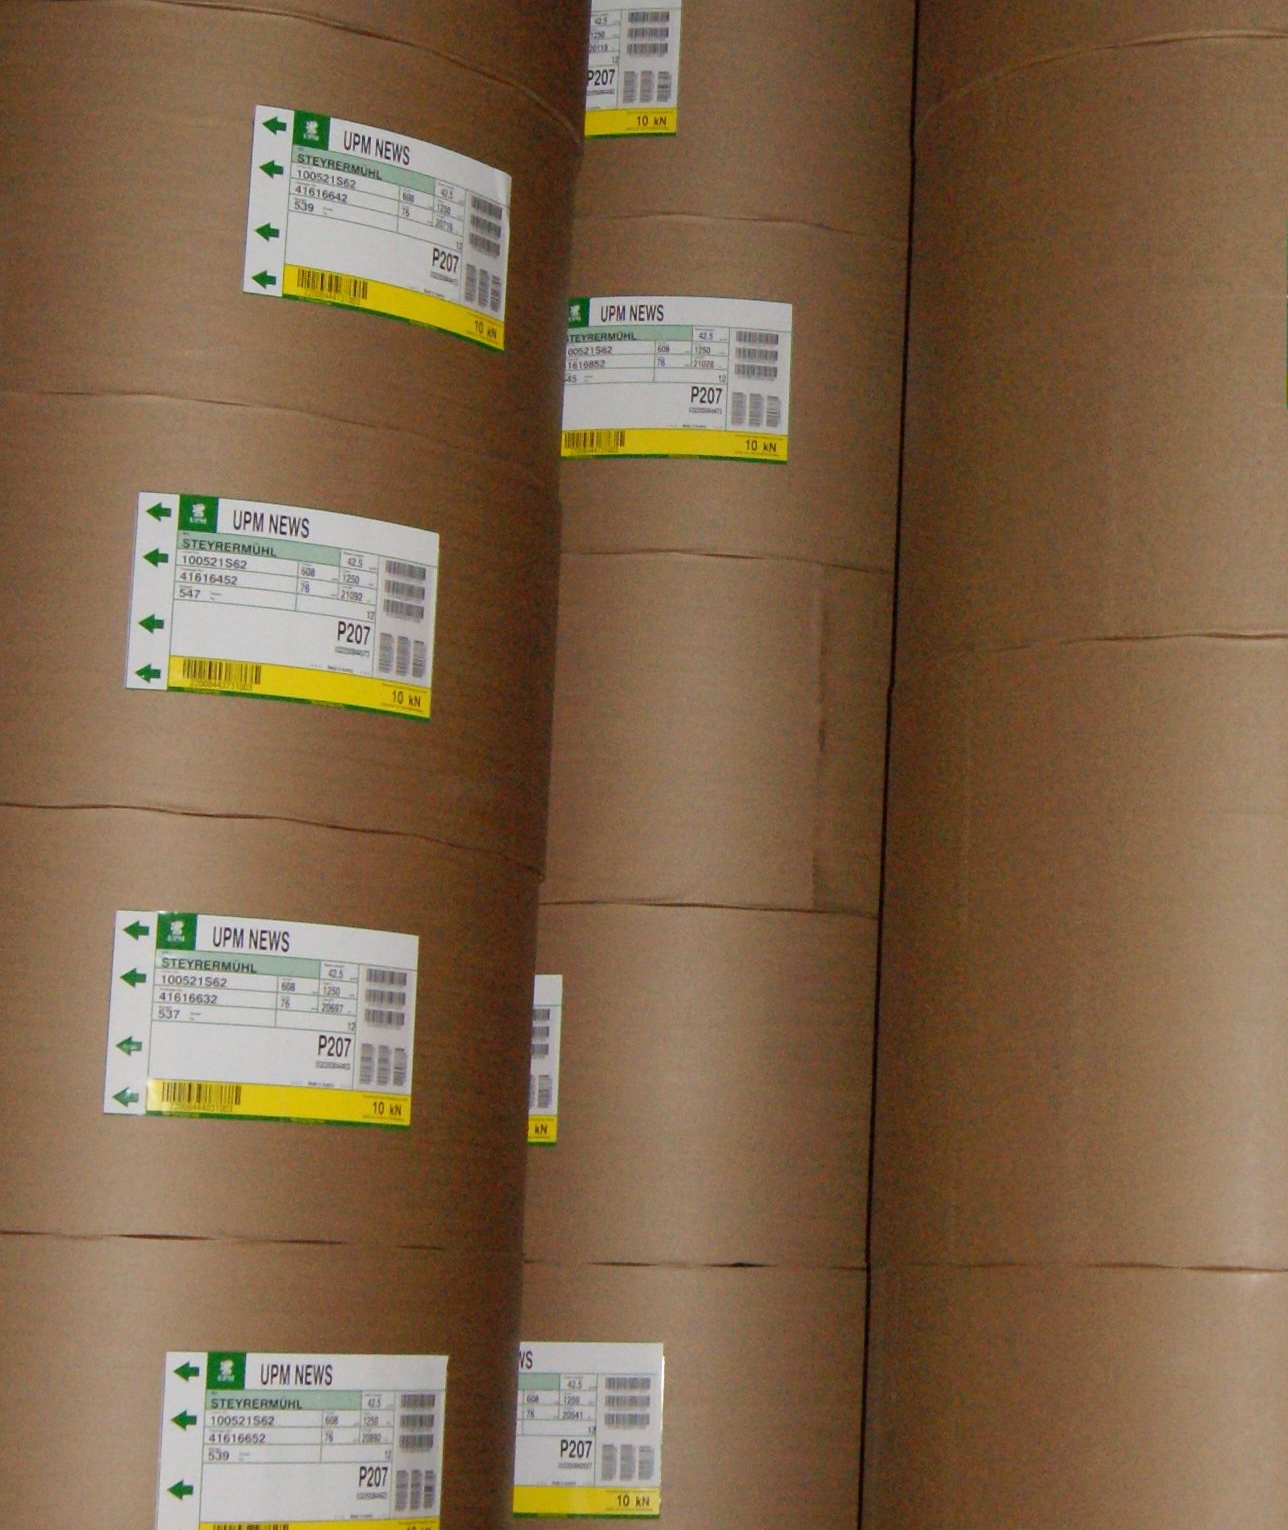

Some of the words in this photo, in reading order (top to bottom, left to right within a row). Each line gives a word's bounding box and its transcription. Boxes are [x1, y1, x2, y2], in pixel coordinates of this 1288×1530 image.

[344, 131, 371, 153] UPM
[375, 140, 410, 165] NEWS
[295, 186, 348, 202] 41616642
[295, 201, 314, 212] 539
[601, 305, 625, 322] UPM
[630, 305, 664, 322] NEWS
[691, 386, 722, 404] P207
[745, 440, 758, 451] 10
[763, 441, 776, 452] kN
[233, 510, 264, 531] UPM
[269, 514, 310, 538] NEWS
[183, 538, 276, 557] STEYRERMÜHL
[183, 556, 247, 569] 100521S62
[347, 557, 363, 568] 42.5
[180, 572, 237, 585] 41616452
[343, 574, 360, 585] 1250
[179, 589, 200, 599] 547
[337, 621, 370, 645] P207
[392, 690, 403, 705] 10
[409, 694, 421, 706] kN
[213, 926, 244, 948] UPM
[249, 929, 290, 952] NEWS
[162, 958, 257, 973] STEYRERMÜHL
[161, 975, 227, 988] 100521S62
[159, 992, 217, 1004] 41616632
[158, 1010, 180, 1019] 537
[318, 1035, 351, 1057] P207
[373, 1101, 385, 1115] 10
[390, 1104, 401, 1116] kN
[261, 1364, 290, 1386] UPM
[295, 1365, 333, 1386] NEWS
[211, 1397, 302, 1409] STEYRERMÜHL
[211, 1416, 274, 1426] 100521S62
[209, 1433, 266, 1444] 41616652
[208, 1450, 229, 1461] 539
[561, 1440, 592, 1458] P207
[359, 1466, 388, 1486] P207
[617, 1495, 629, 1506] 10
[636, 1496, 649, 1506] kN
